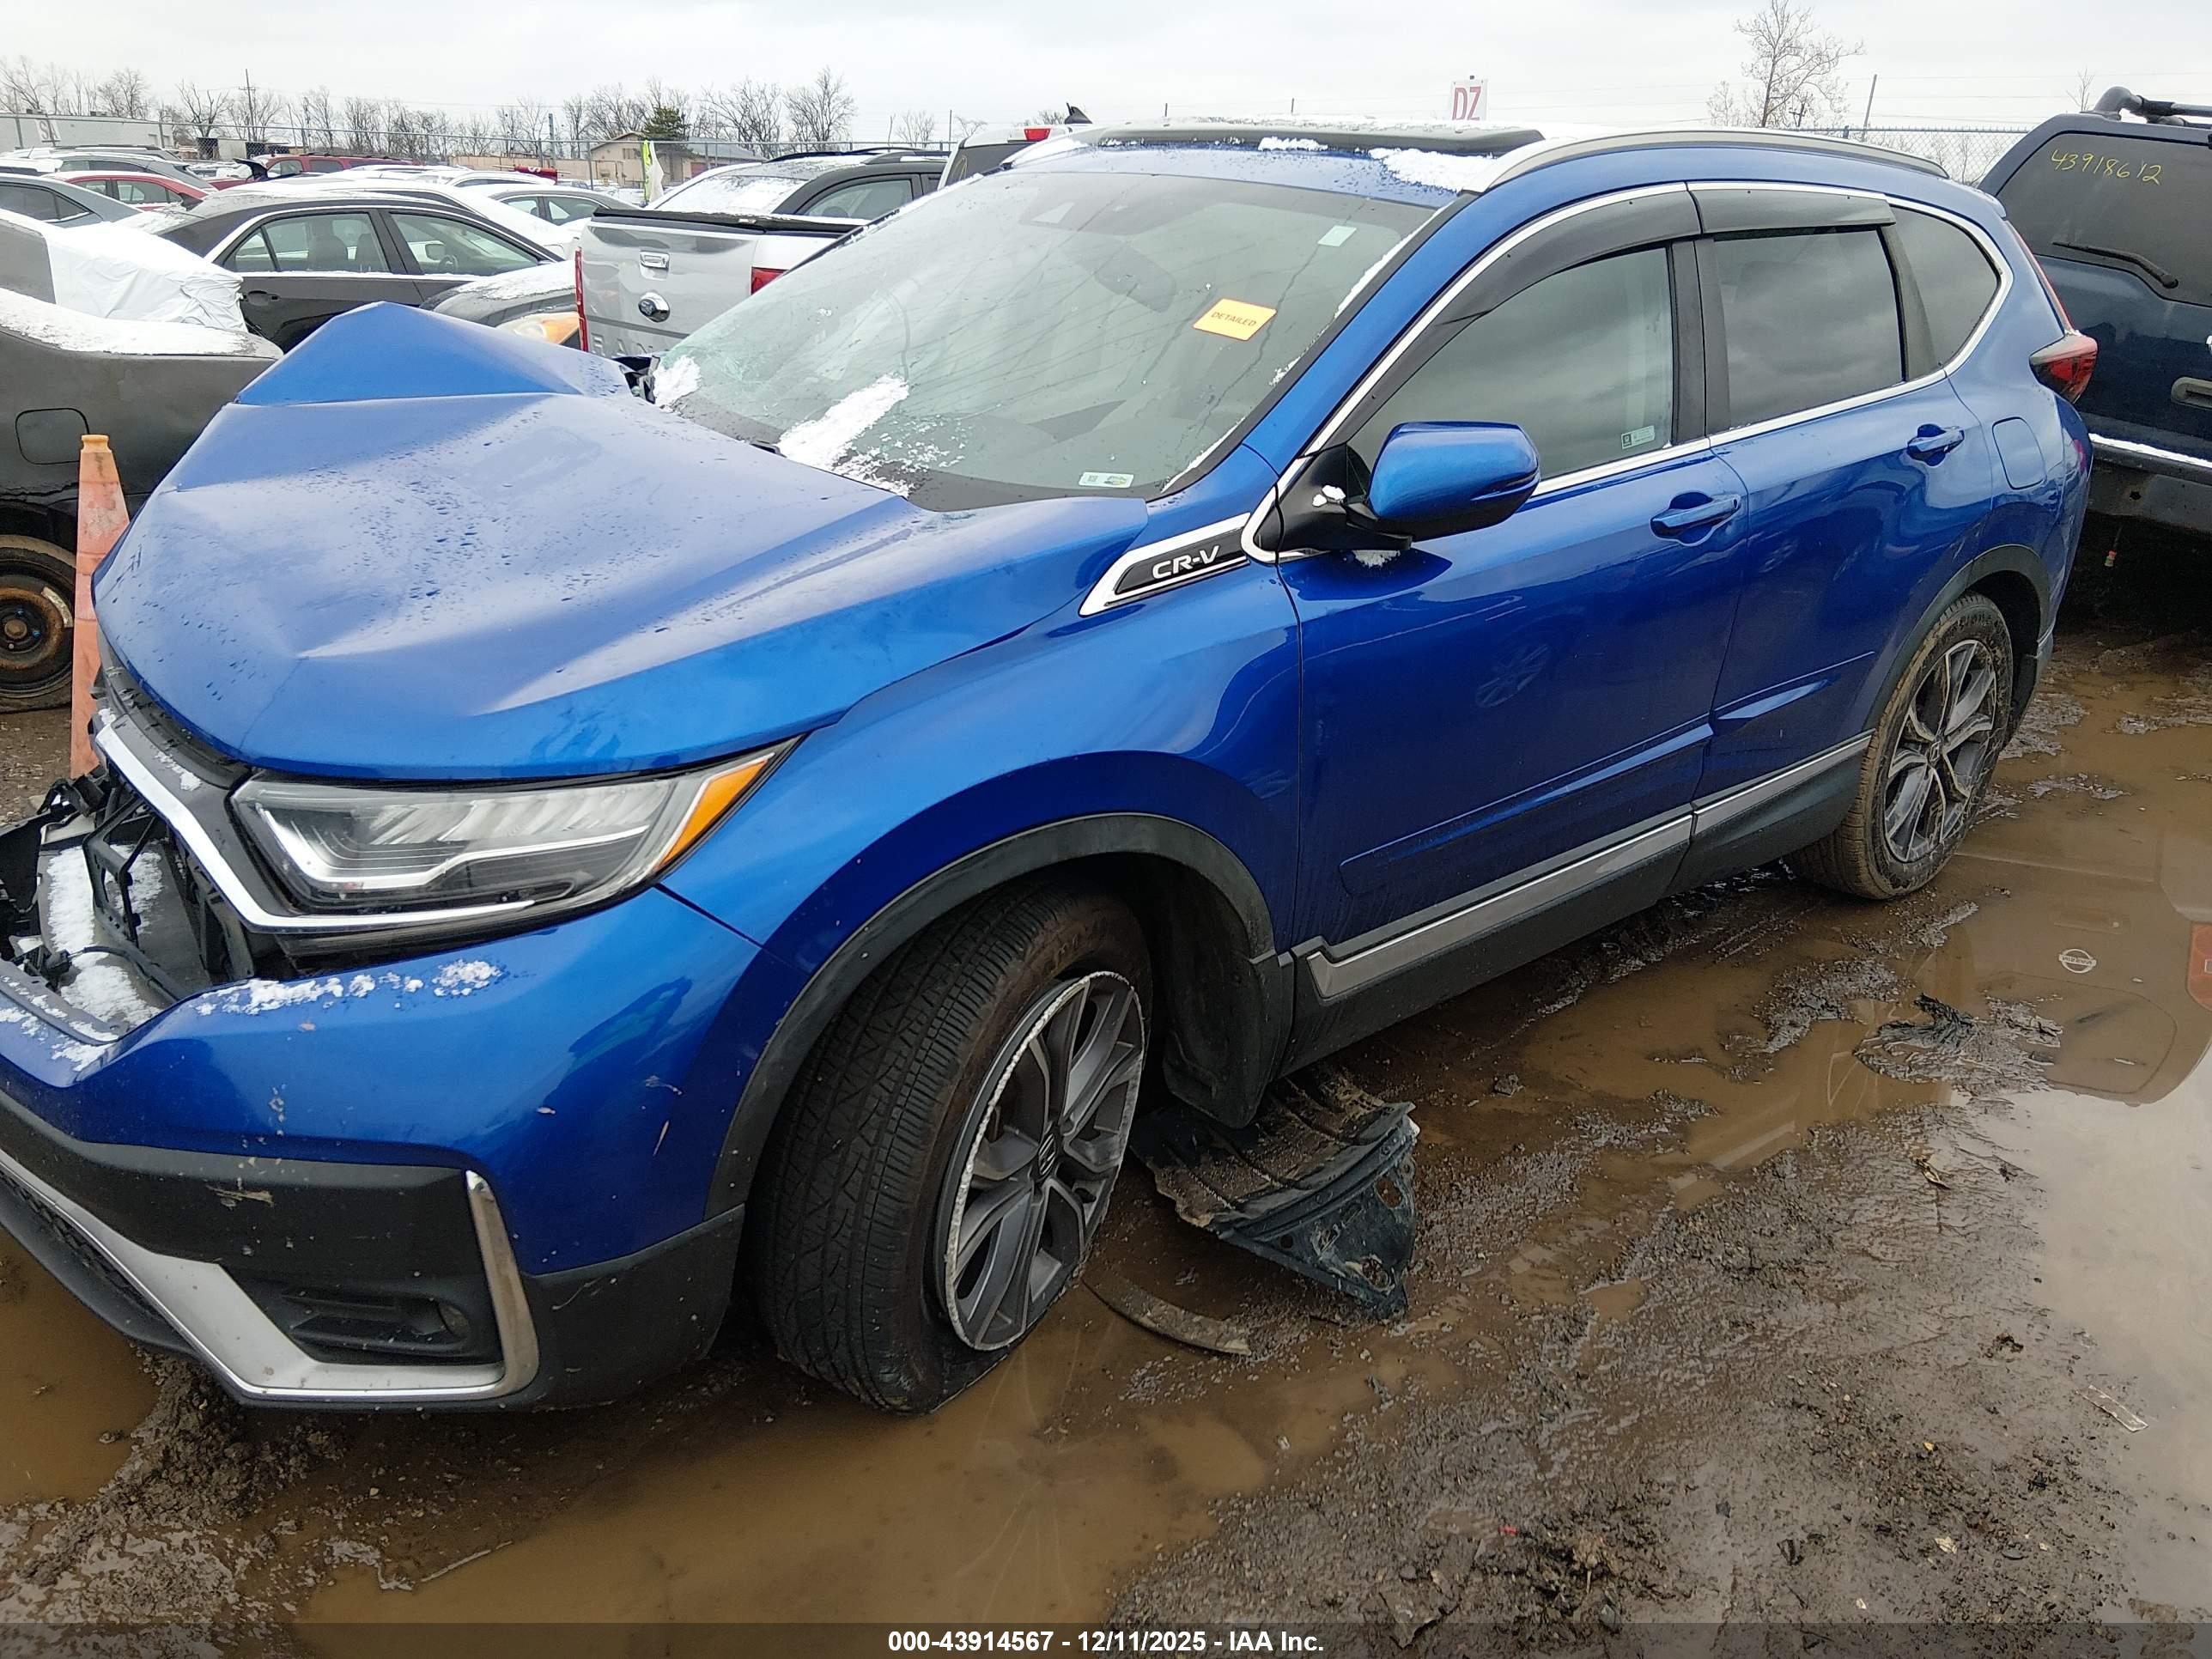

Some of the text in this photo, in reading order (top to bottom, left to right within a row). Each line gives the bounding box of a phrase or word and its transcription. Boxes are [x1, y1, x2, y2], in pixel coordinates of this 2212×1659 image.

[1452, 86, 1481, 120] DZ
[2051, 149, 2161, 185] 43918612
[1211, 311, 1257, 327] DETAILED
[1152, 544, 1220, 580] CR-V
